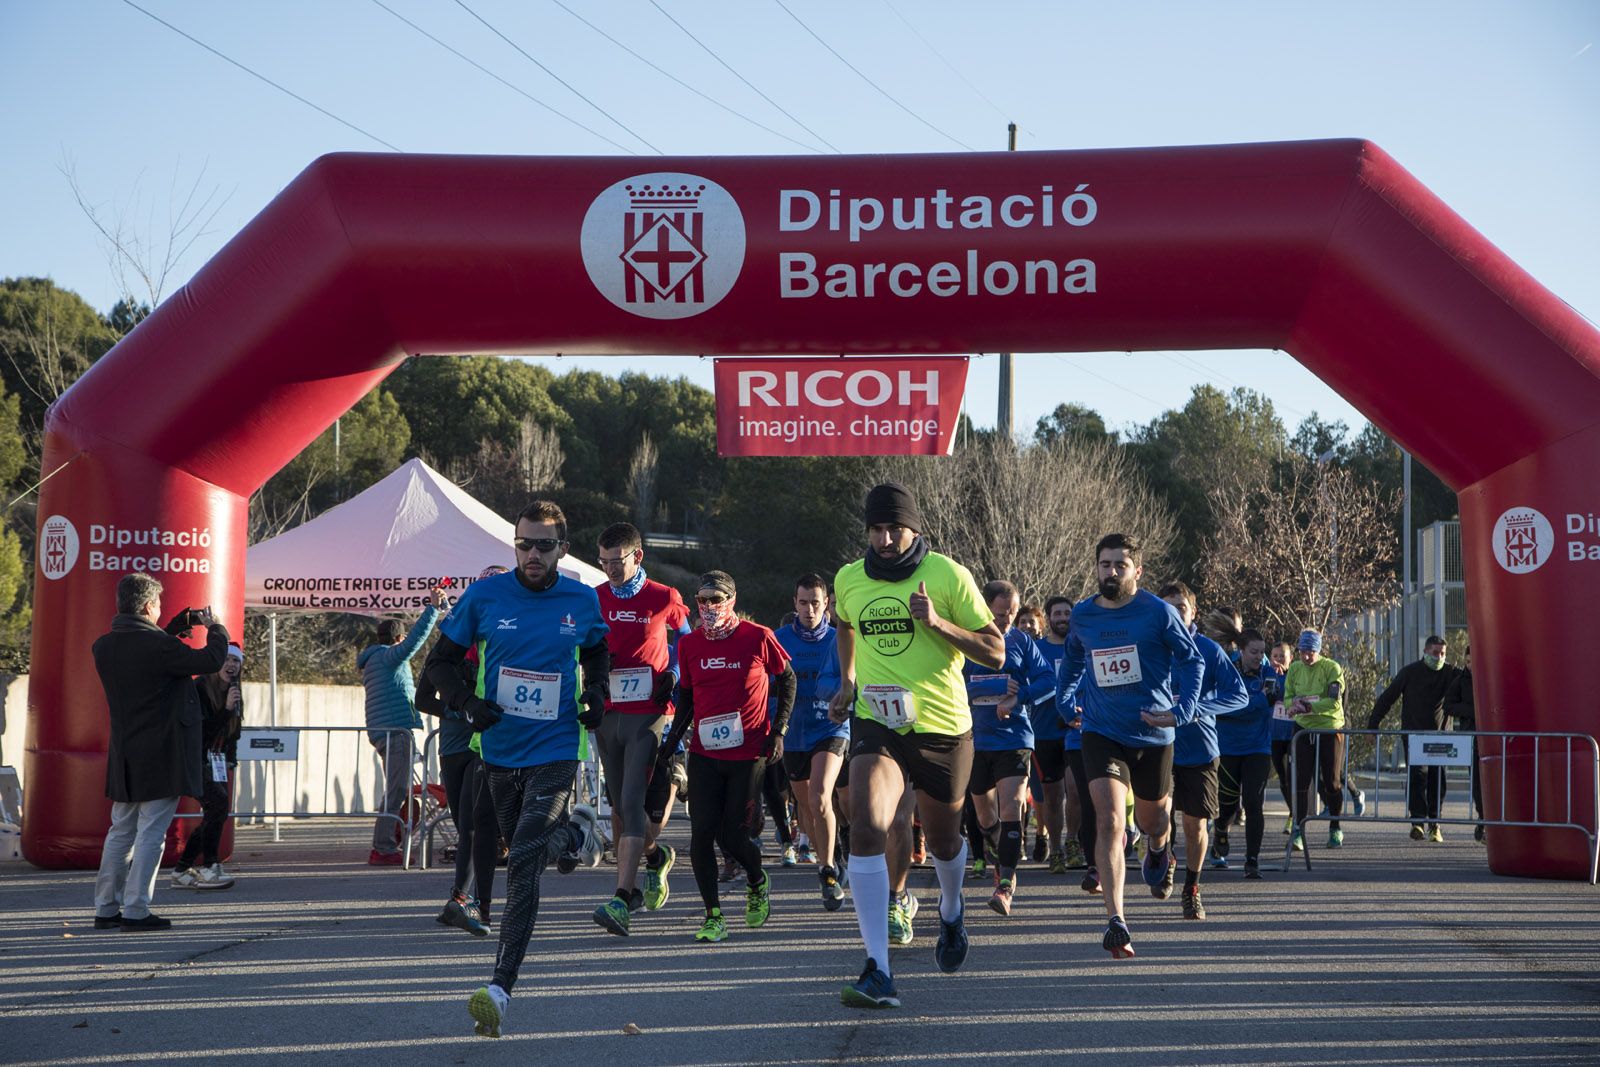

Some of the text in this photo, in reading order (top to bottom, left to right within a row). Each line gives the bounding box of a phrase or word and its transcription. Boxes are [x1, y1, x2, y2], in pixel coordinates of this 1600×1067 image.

[779, 184, 1098, 242] Diputació
[779, 250, 1097, 299] Barcelona
[738, 370, 939, 407] RICOH
[739, 415, 944, 443] imagine. change.
[1566, 512, 1600, 538] Di
[89, 525, 211, 549] Diputació
[89, 551, 210, 573] Barcelona
[263, 576, 477, 591] CRONOMETRATGE ESPORTI
[869, 606, 901, 617] RICOH
[864, 620, 908, 635] Sports
[877, 638, 901, 648] Club
[1100, 659, 1131, 676] 149
[515, 685, 543, 705] 84
[620, 679, 640, 693] 77
[711, 726, 730, 740] 49
